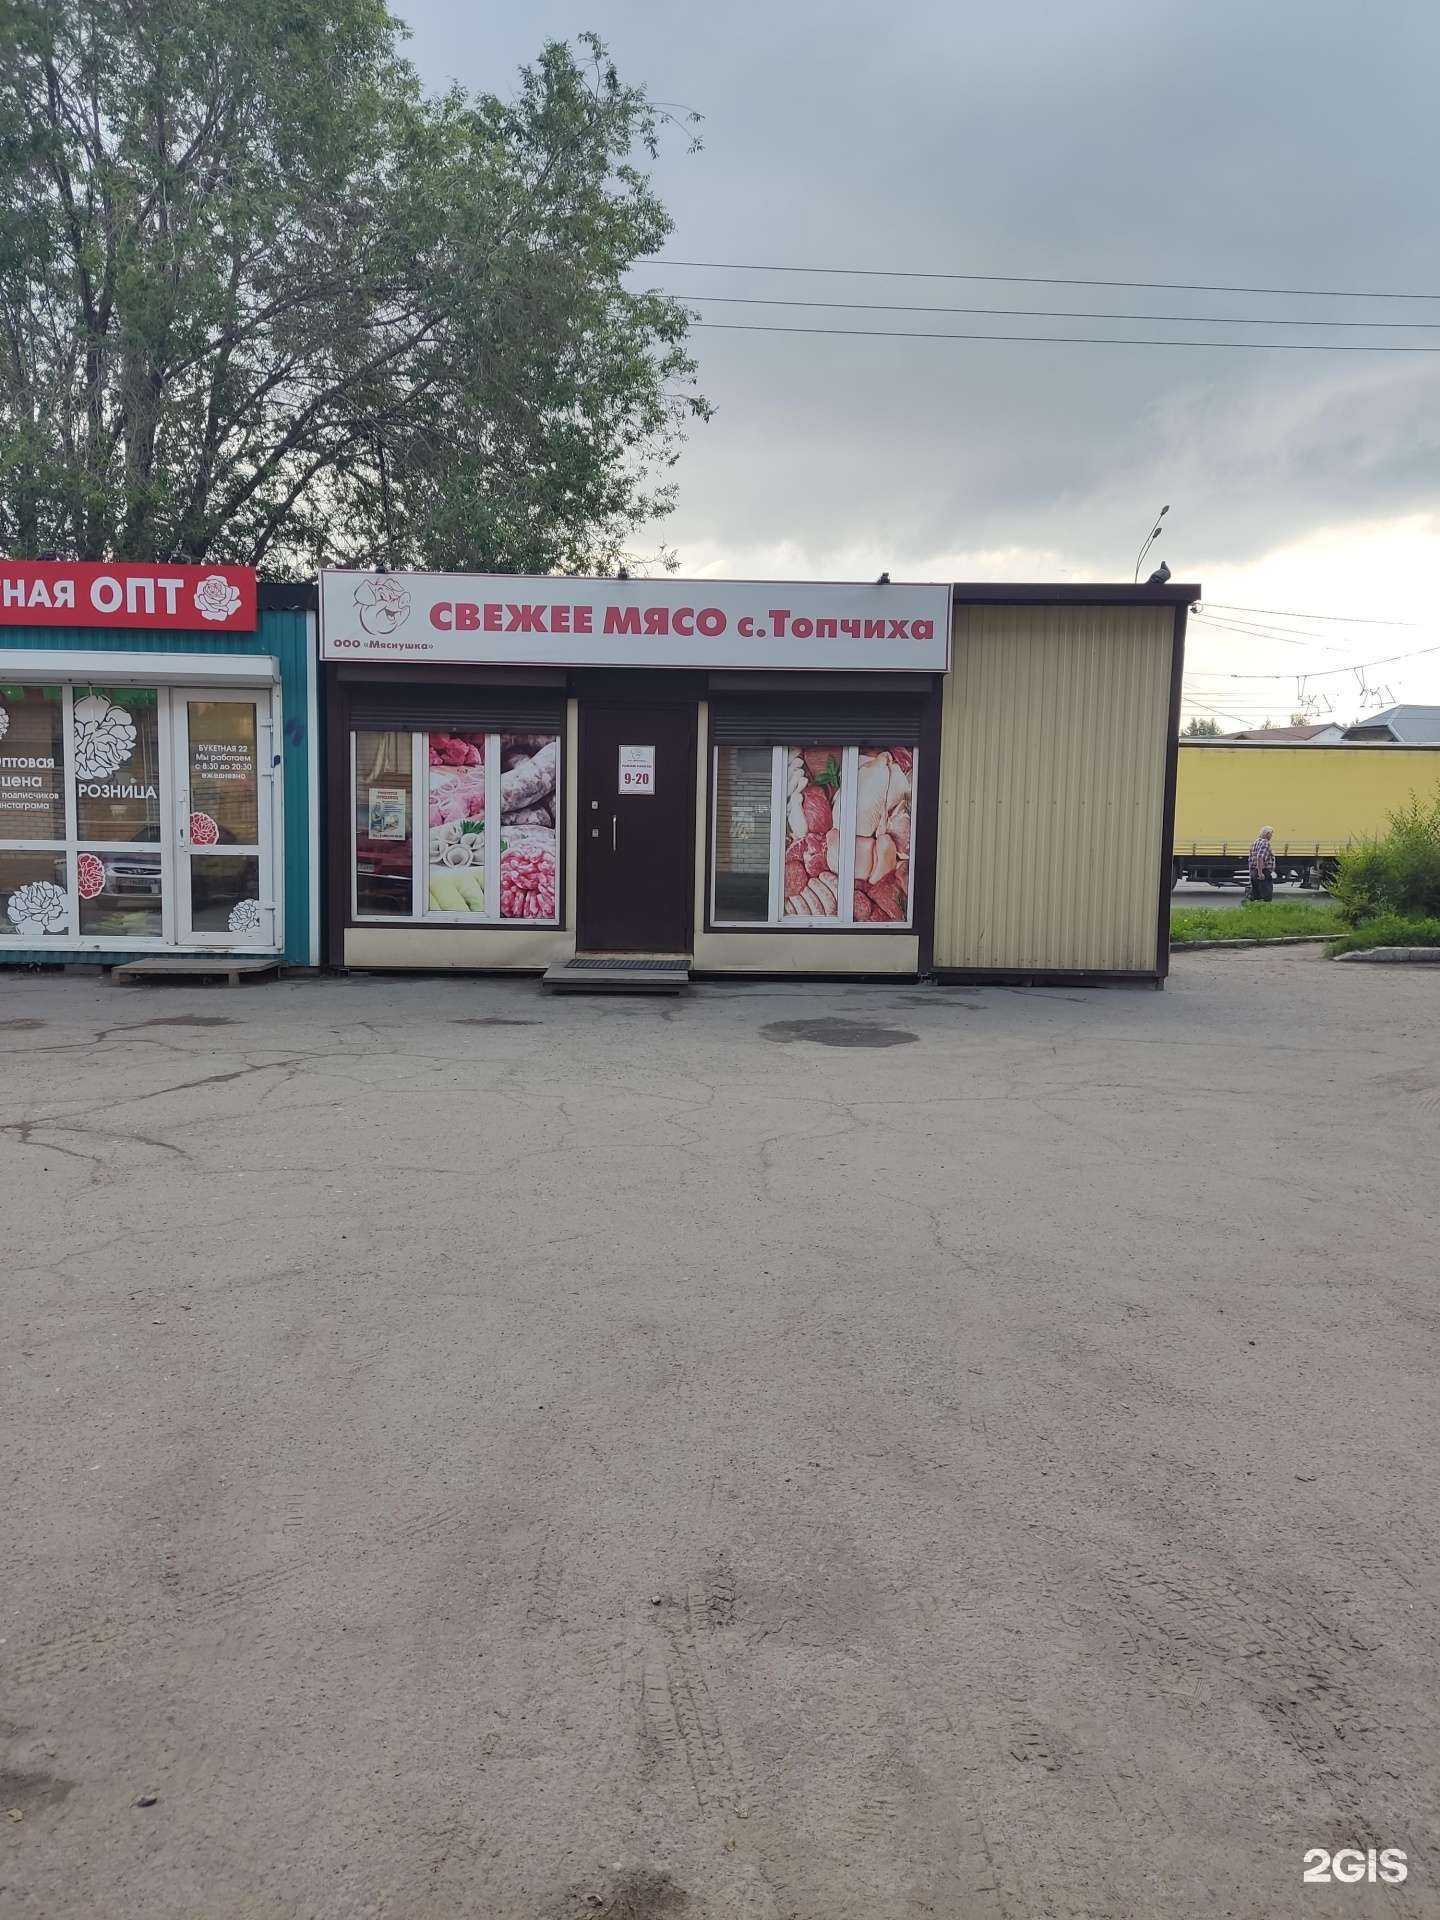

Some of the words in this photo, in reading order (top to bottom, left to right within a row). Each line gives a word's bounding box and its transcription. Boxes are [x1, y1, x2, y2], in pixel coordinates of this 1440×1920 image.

[0, 579, 75, 608] НАЯ
[90, 576, 184, 615] ОПТ
[429, 602, 593, 633] СВЕЖЕЕ
[603, 606, 727, 637] МЯСО
[737, 609, 935, 640] с.Топчиха
[333, 639, 361, 648] ООО
[198, 744, 237, 753] БУКЕТНАЯ
[238, 745, 249, 753] 22
[0, 757, 55, 769] птовая
[195, 753, 209, 761] Мы
[210, 753, 251, 763] работаем
[1, 776, 43, 788] цена
[78, 783, 158, 799] РОЗНИЦА
